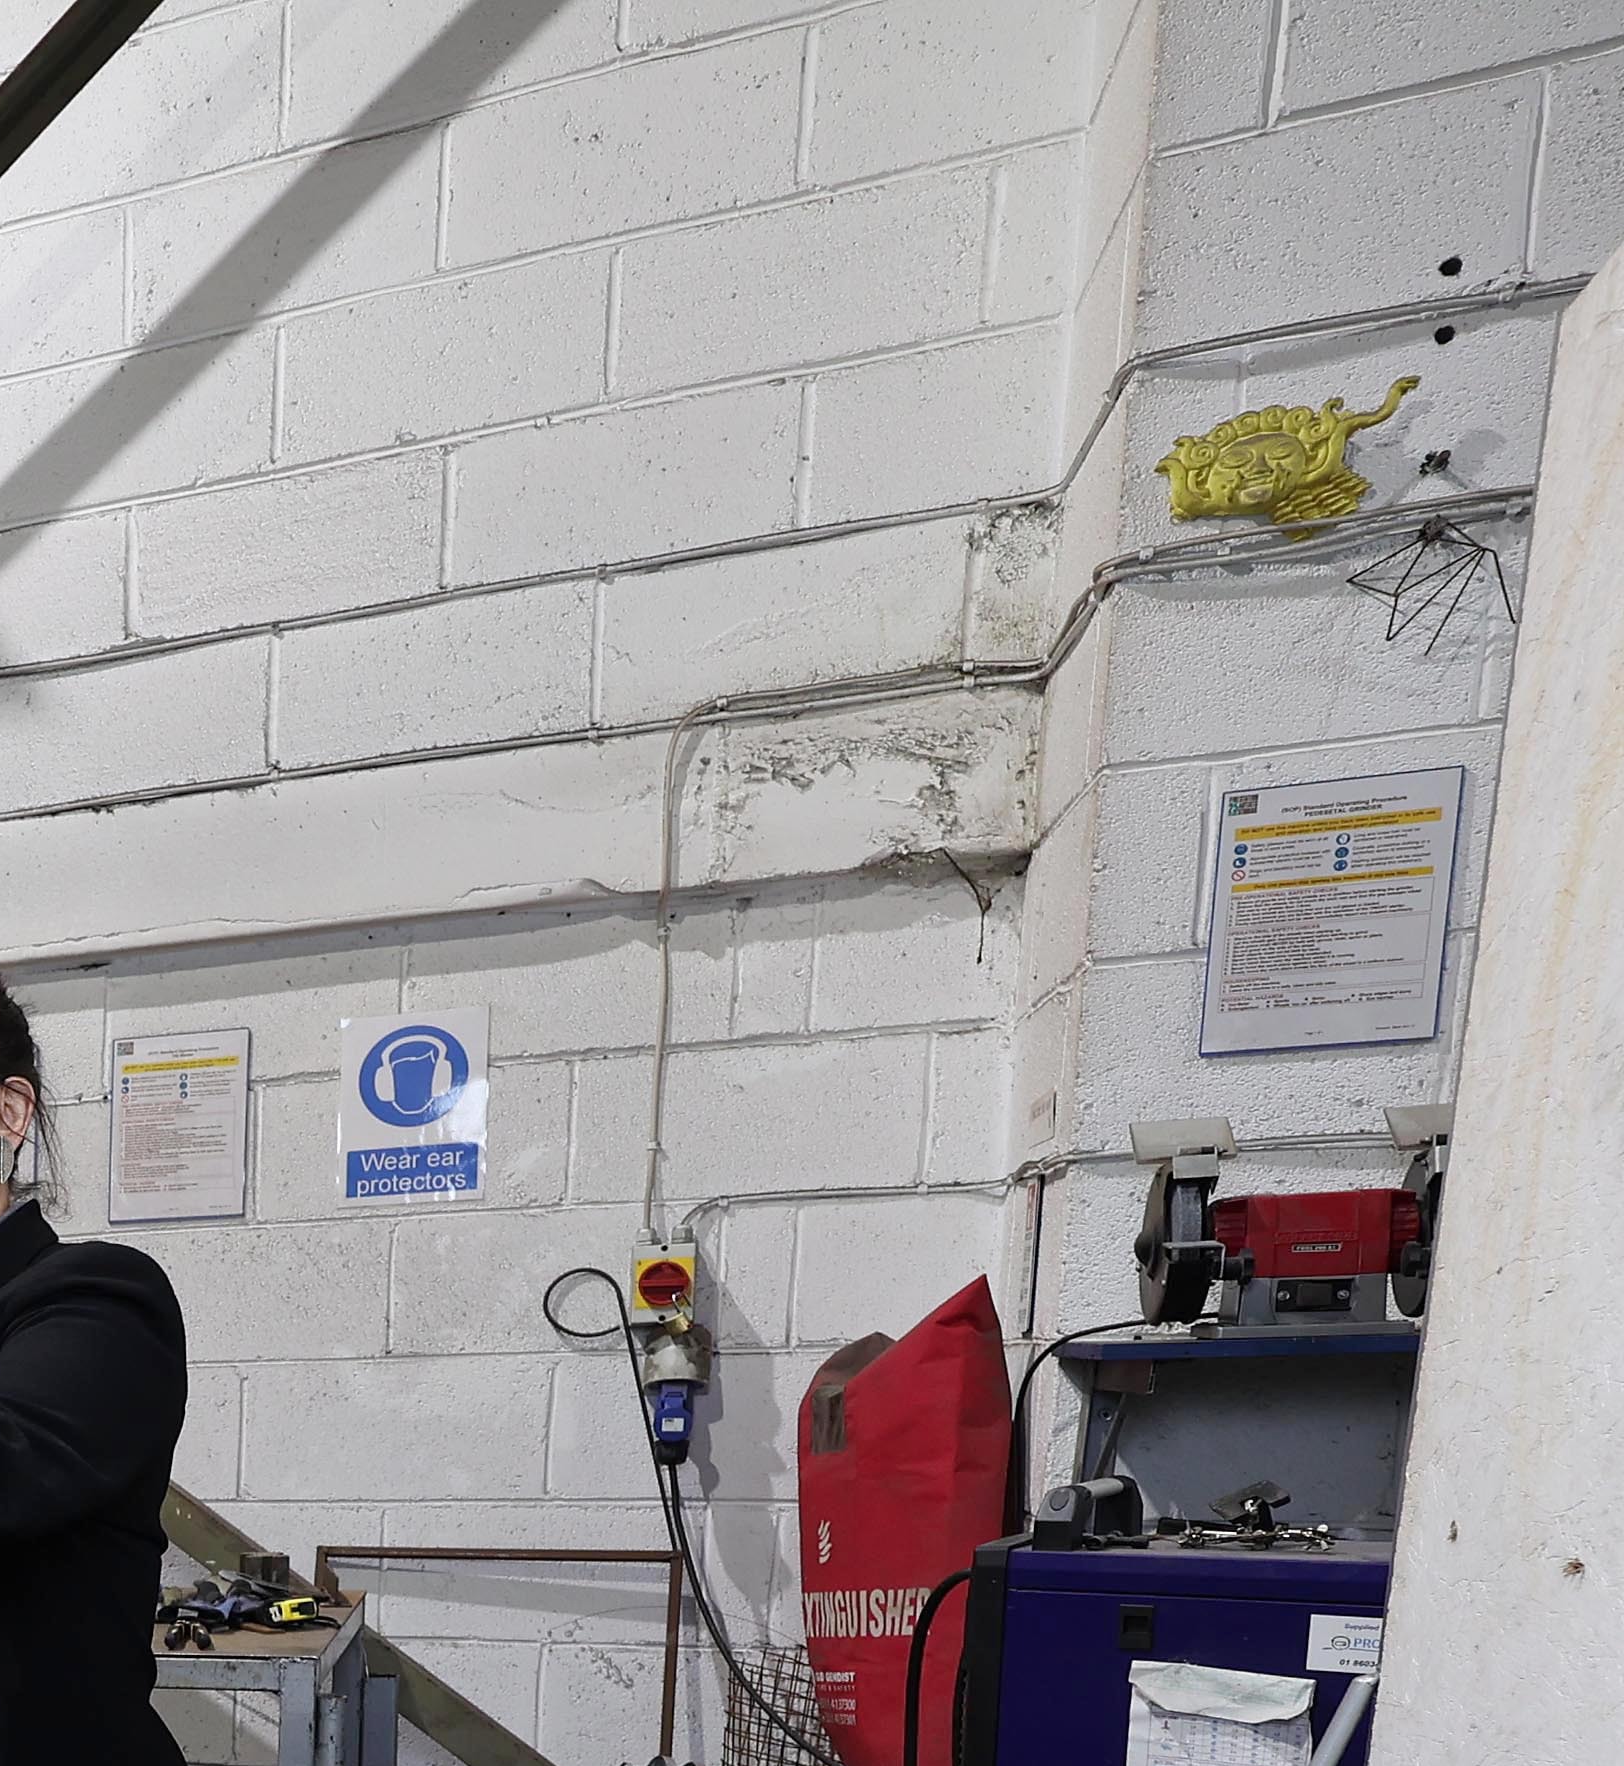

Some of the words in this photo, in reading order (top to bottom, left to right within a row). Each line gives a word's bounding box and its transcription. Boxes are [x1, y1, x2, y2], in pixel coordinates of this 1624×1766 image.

[360, 1152, 421, 1172] Wear
[426, 1150, 464, 1168] ear
[356, 1172, 467, 1198] protectors
